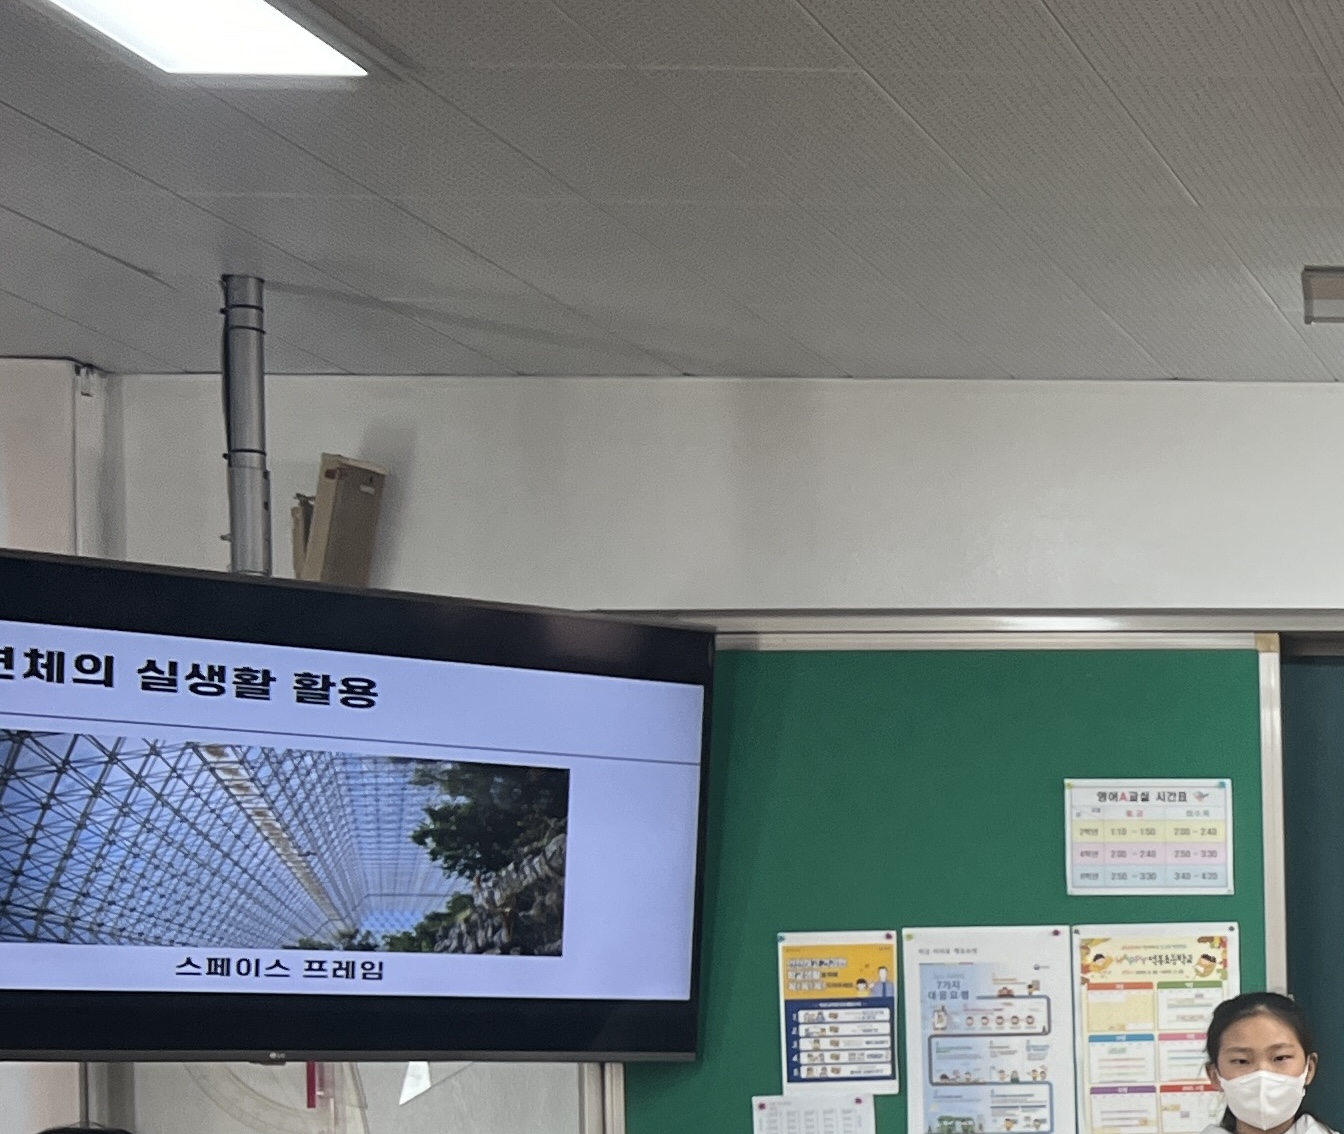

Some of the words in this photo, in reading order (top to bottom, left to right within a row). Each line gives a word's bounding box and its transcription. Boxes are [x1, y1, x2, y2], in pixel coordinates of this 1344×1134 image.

[137, 659, 276, 701] 실생활
[293, 671, 379, 709] 활용
[175, 957, 291, 978] 스페이스
[302, 959, 384, 981] 프레임
